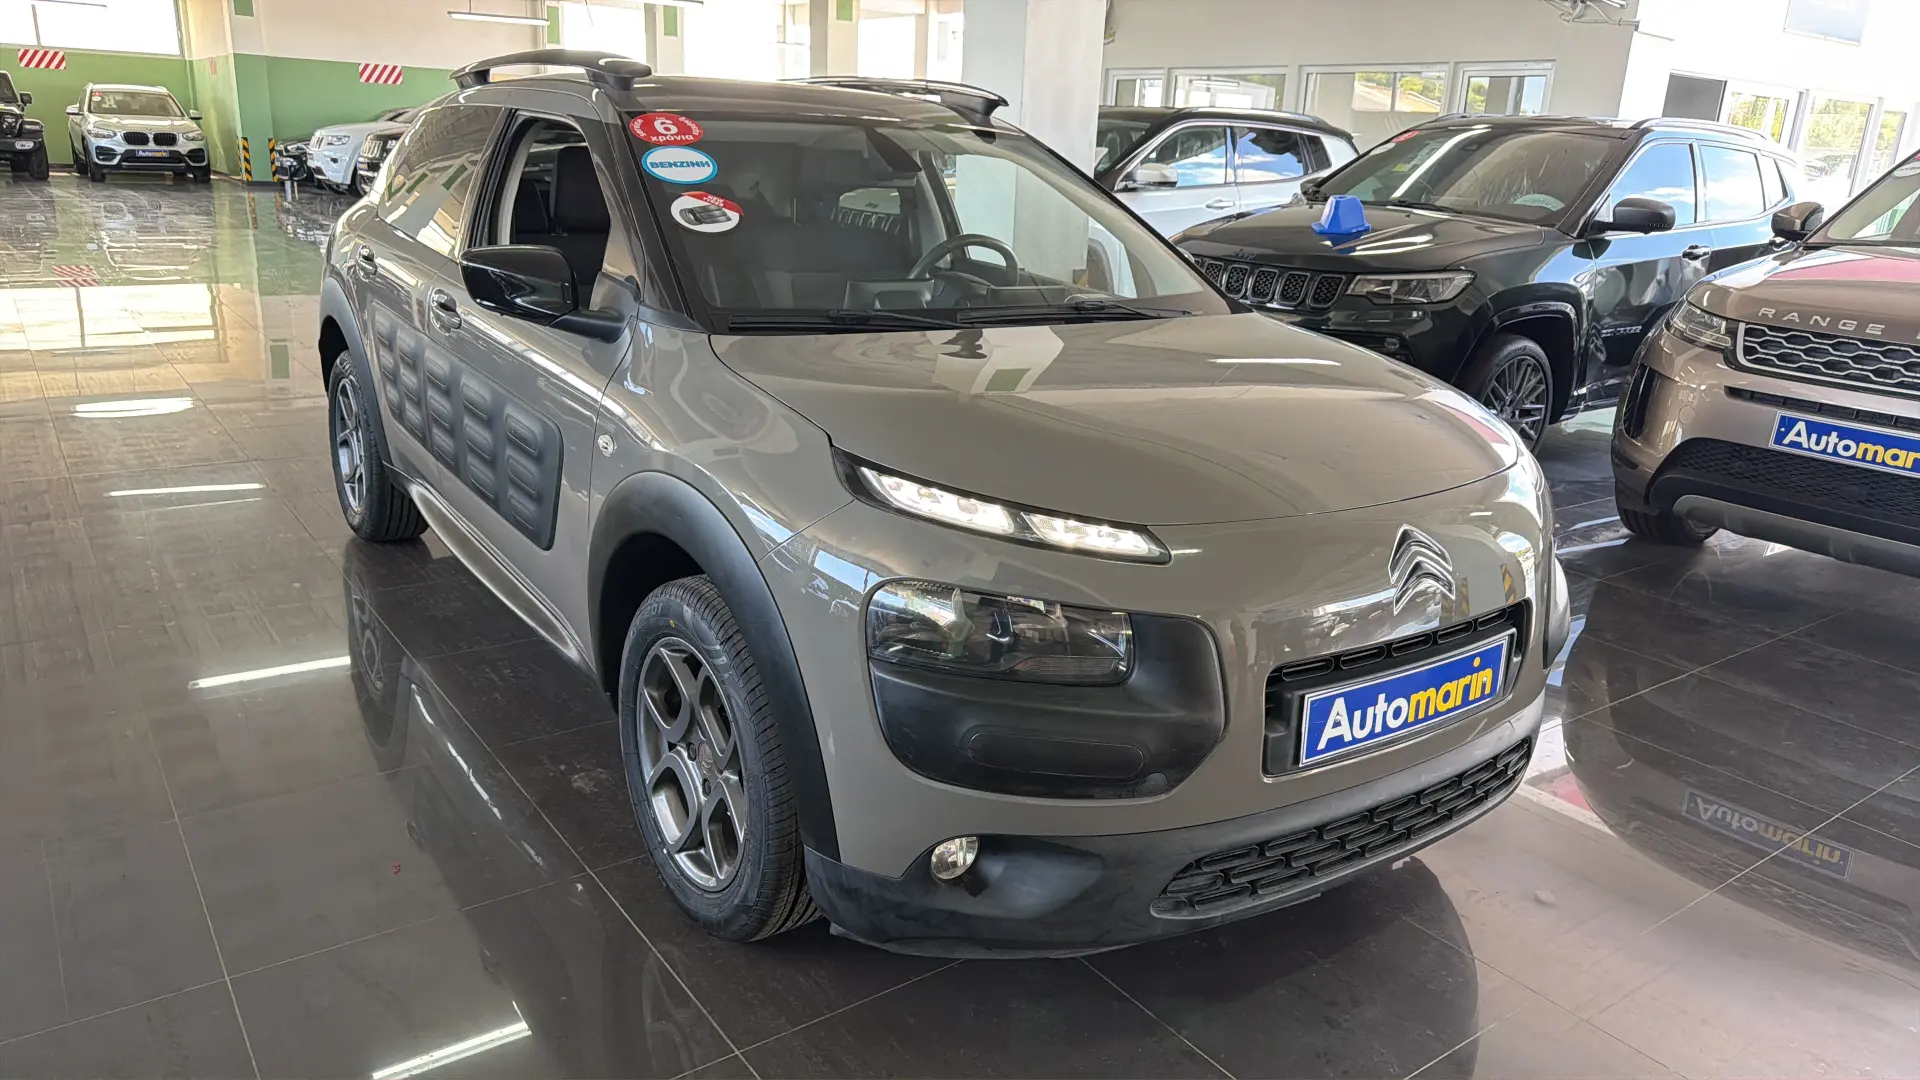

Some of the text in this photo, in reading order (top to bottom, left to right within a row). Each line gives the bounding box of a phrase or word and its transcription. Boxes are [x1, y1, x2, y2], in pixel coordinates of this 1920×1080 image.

[650, 134, 695, 142] χρόνια
[653, 119, 679, 135] 6
[1757, 307, 1886, 335] RANGE
[1316, 657, 1493, 751] Automarin
